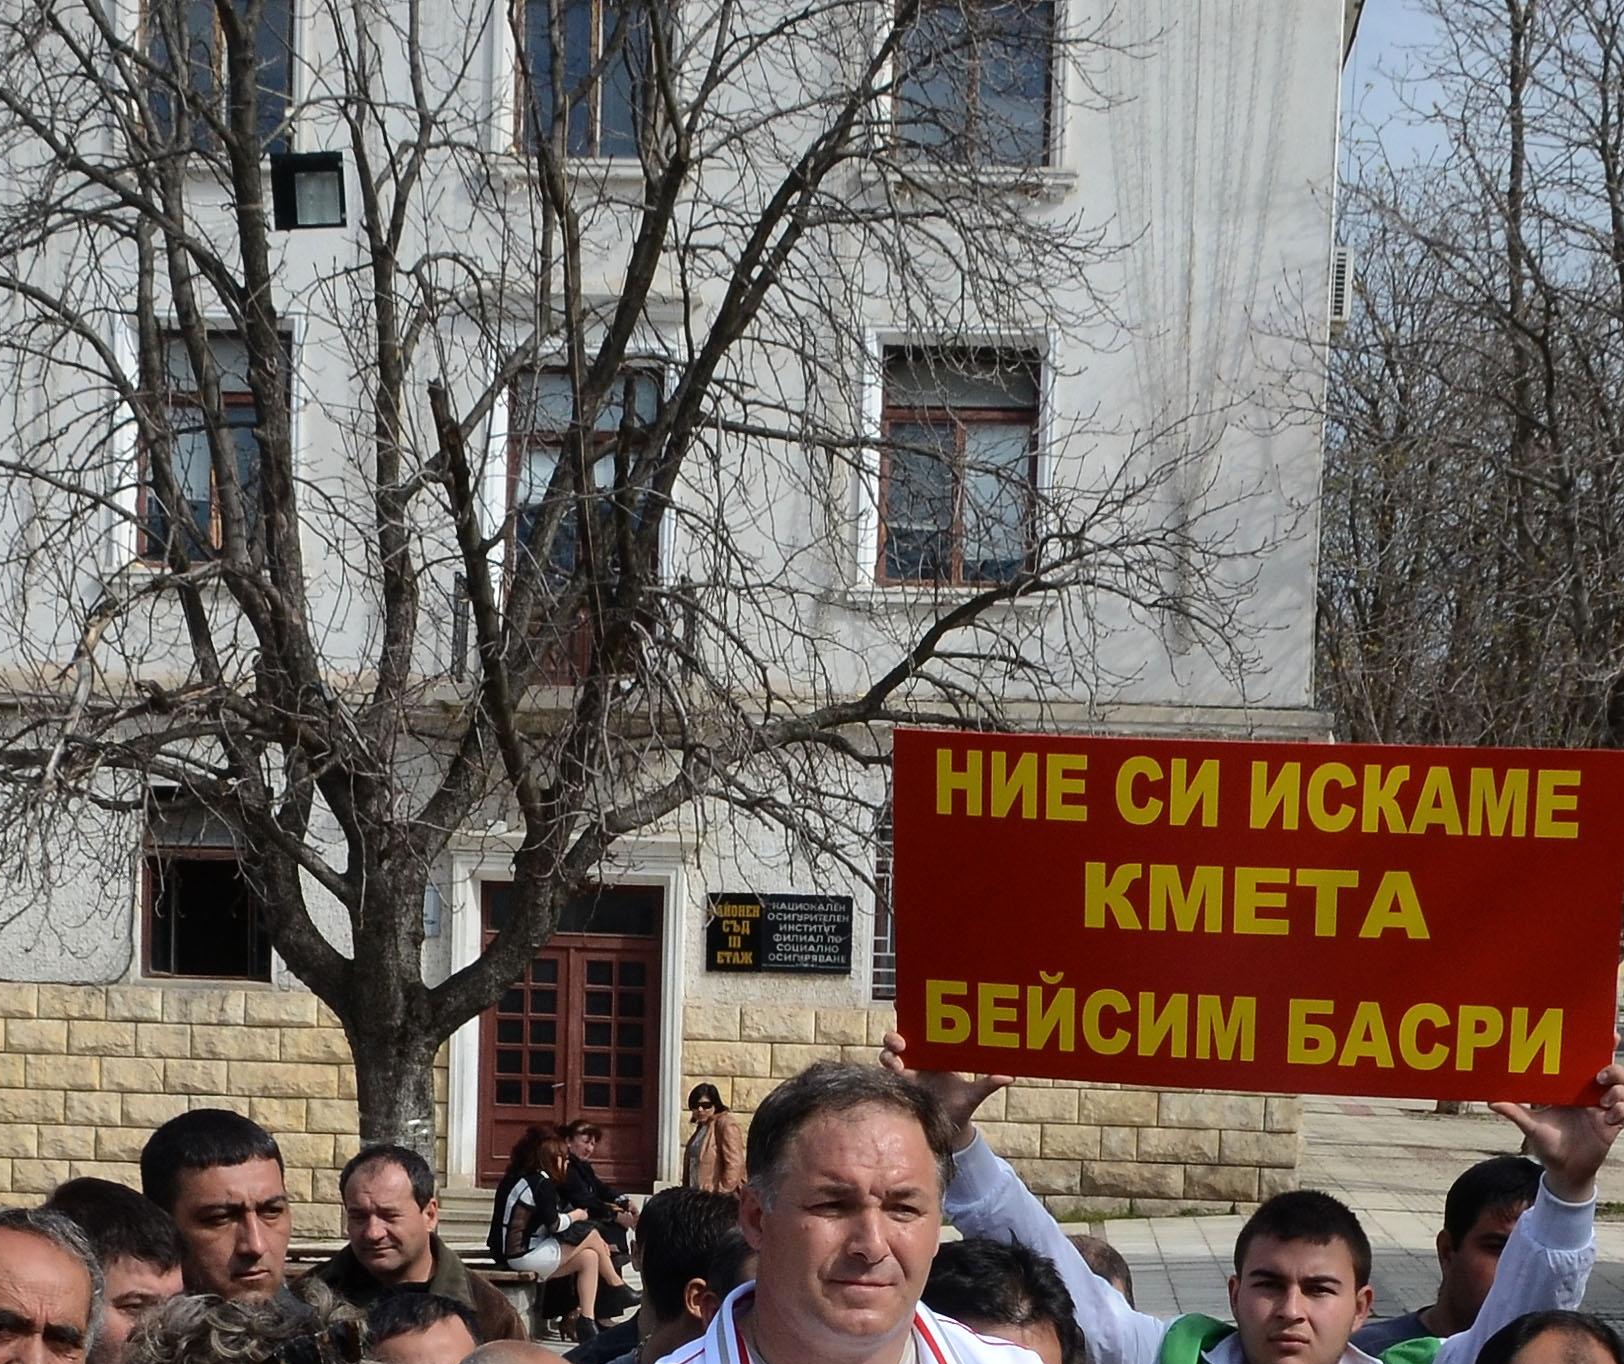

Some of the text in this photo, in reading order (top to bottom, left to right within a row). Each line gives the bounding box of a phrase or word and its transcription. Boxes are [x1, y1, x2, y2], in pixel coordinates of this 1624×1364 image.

[936, 748, 1582, 839] НИЕ СИ ИСКАМЕ
[1083, 861, 1431, 940] КМЕТА
[712, 901, 761, 918] АЙОНЕН
[772, 902, 846, 912] НАЦИОНАЛЕН
[767, 912, 850, 923] ОСИГУРИТЕЛЕН
[722, 920, 751, 935] СЪД
[779, 923, 837, 933] ИНСТИТУТ
[773, 933, 842, 944] ФИЛИАЛ ПО
[776, 943, 840, 953] СОЦИАЛНО
[716, 951, 753, 965] ЕТАЖ
[768, 953, 847, 964] ОСИГУРЯВАНЕ
[925, 970, 1565, 1075] БЕЙСИМ БАСРИ
